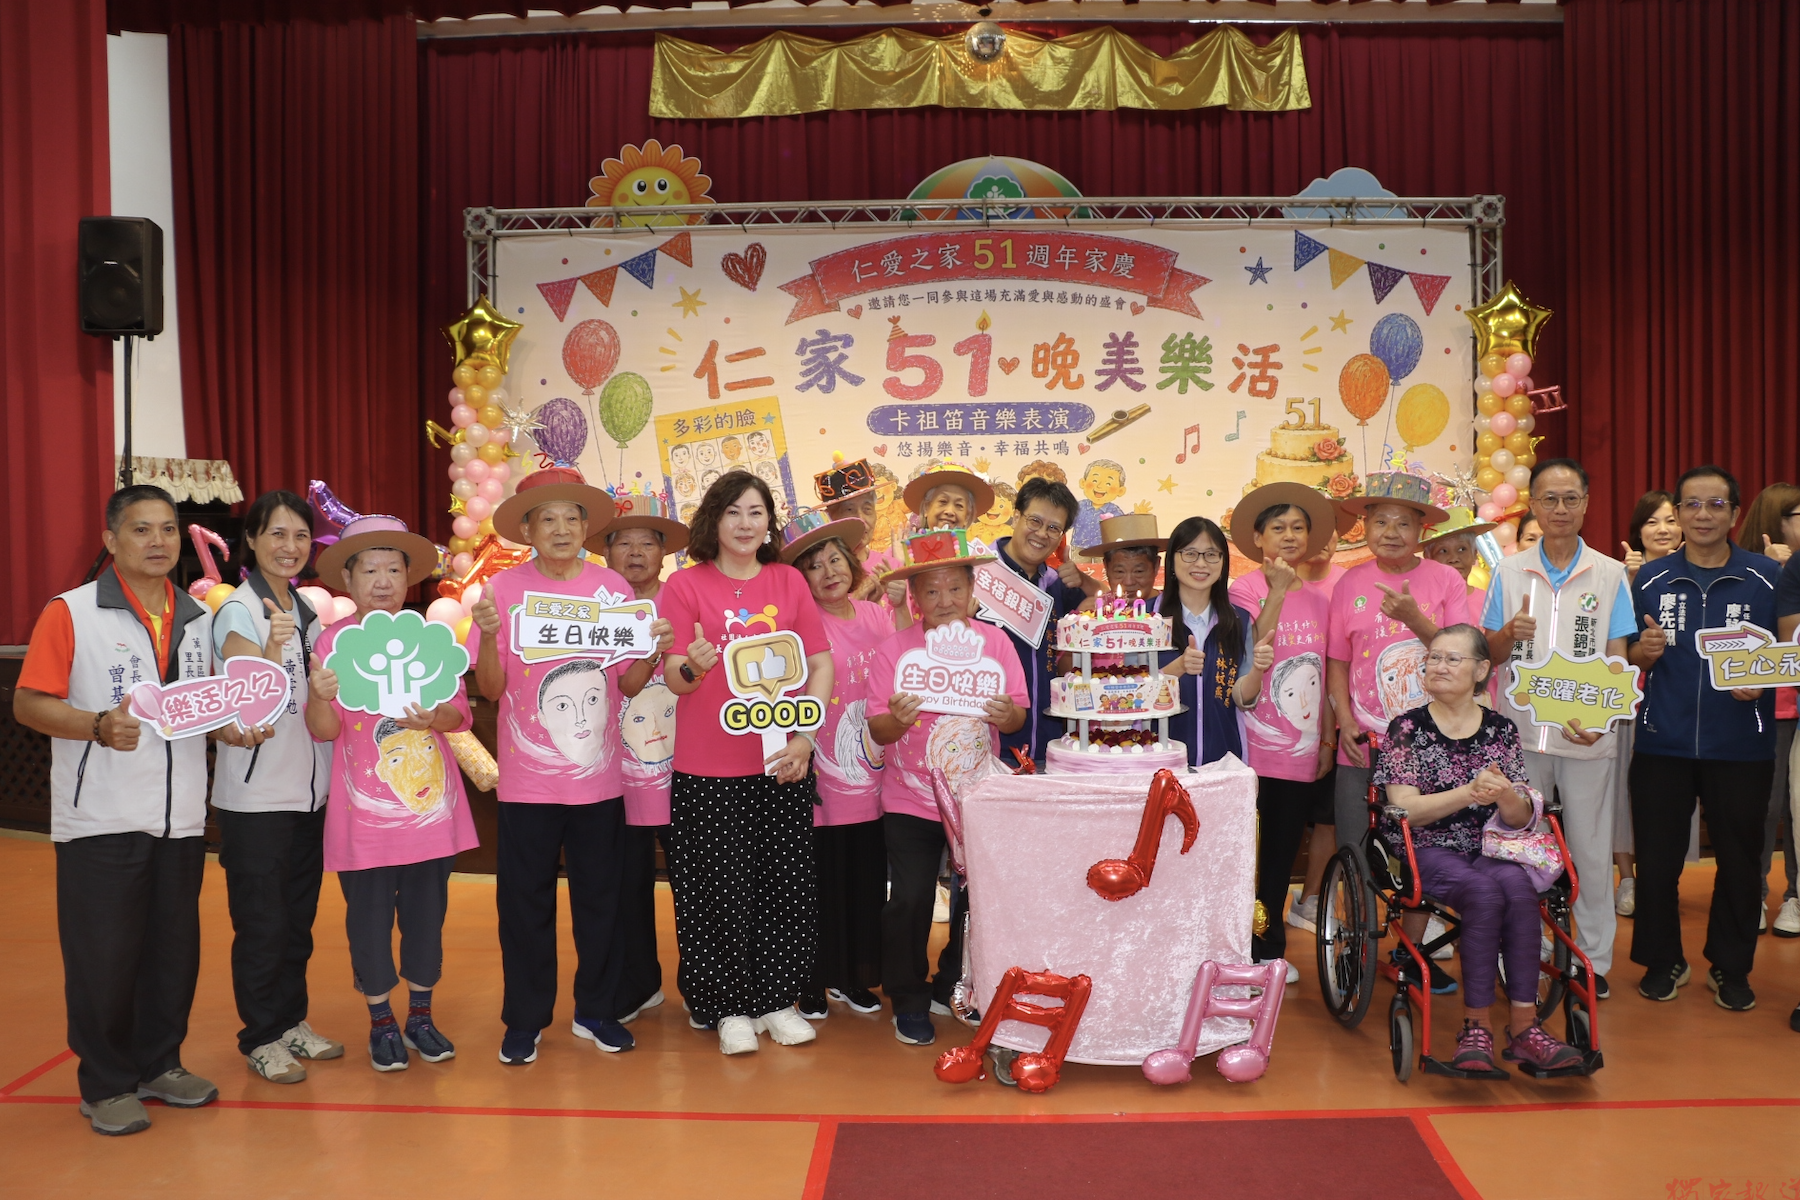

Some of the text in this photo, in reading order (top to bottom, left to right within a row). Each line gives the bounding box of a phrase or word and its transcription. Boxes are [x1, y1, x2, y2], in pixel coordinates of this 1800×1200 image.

[868, 289, 1127, 310] 邀請您一同參與這場充滿愛與感動的盛會
[673, 408, 757, 438] 多彩的臉
[889, 407, 1070, 431] 卡祖笛音樂表演
[1284, 397, 1321, 430] 51
[534, 601, 591, 619] 仁愛之家
[976, 569, 1034, 621] 幸福銀髮
[538, 623, 634, 647] 生日快樂
[129, 654, 141, 683] 會長
[902, 664, 999, 697] 生日快樂
[1528, 675, 1624, 709] 活躍老化
[724, 700, 821, 730] GOOD
